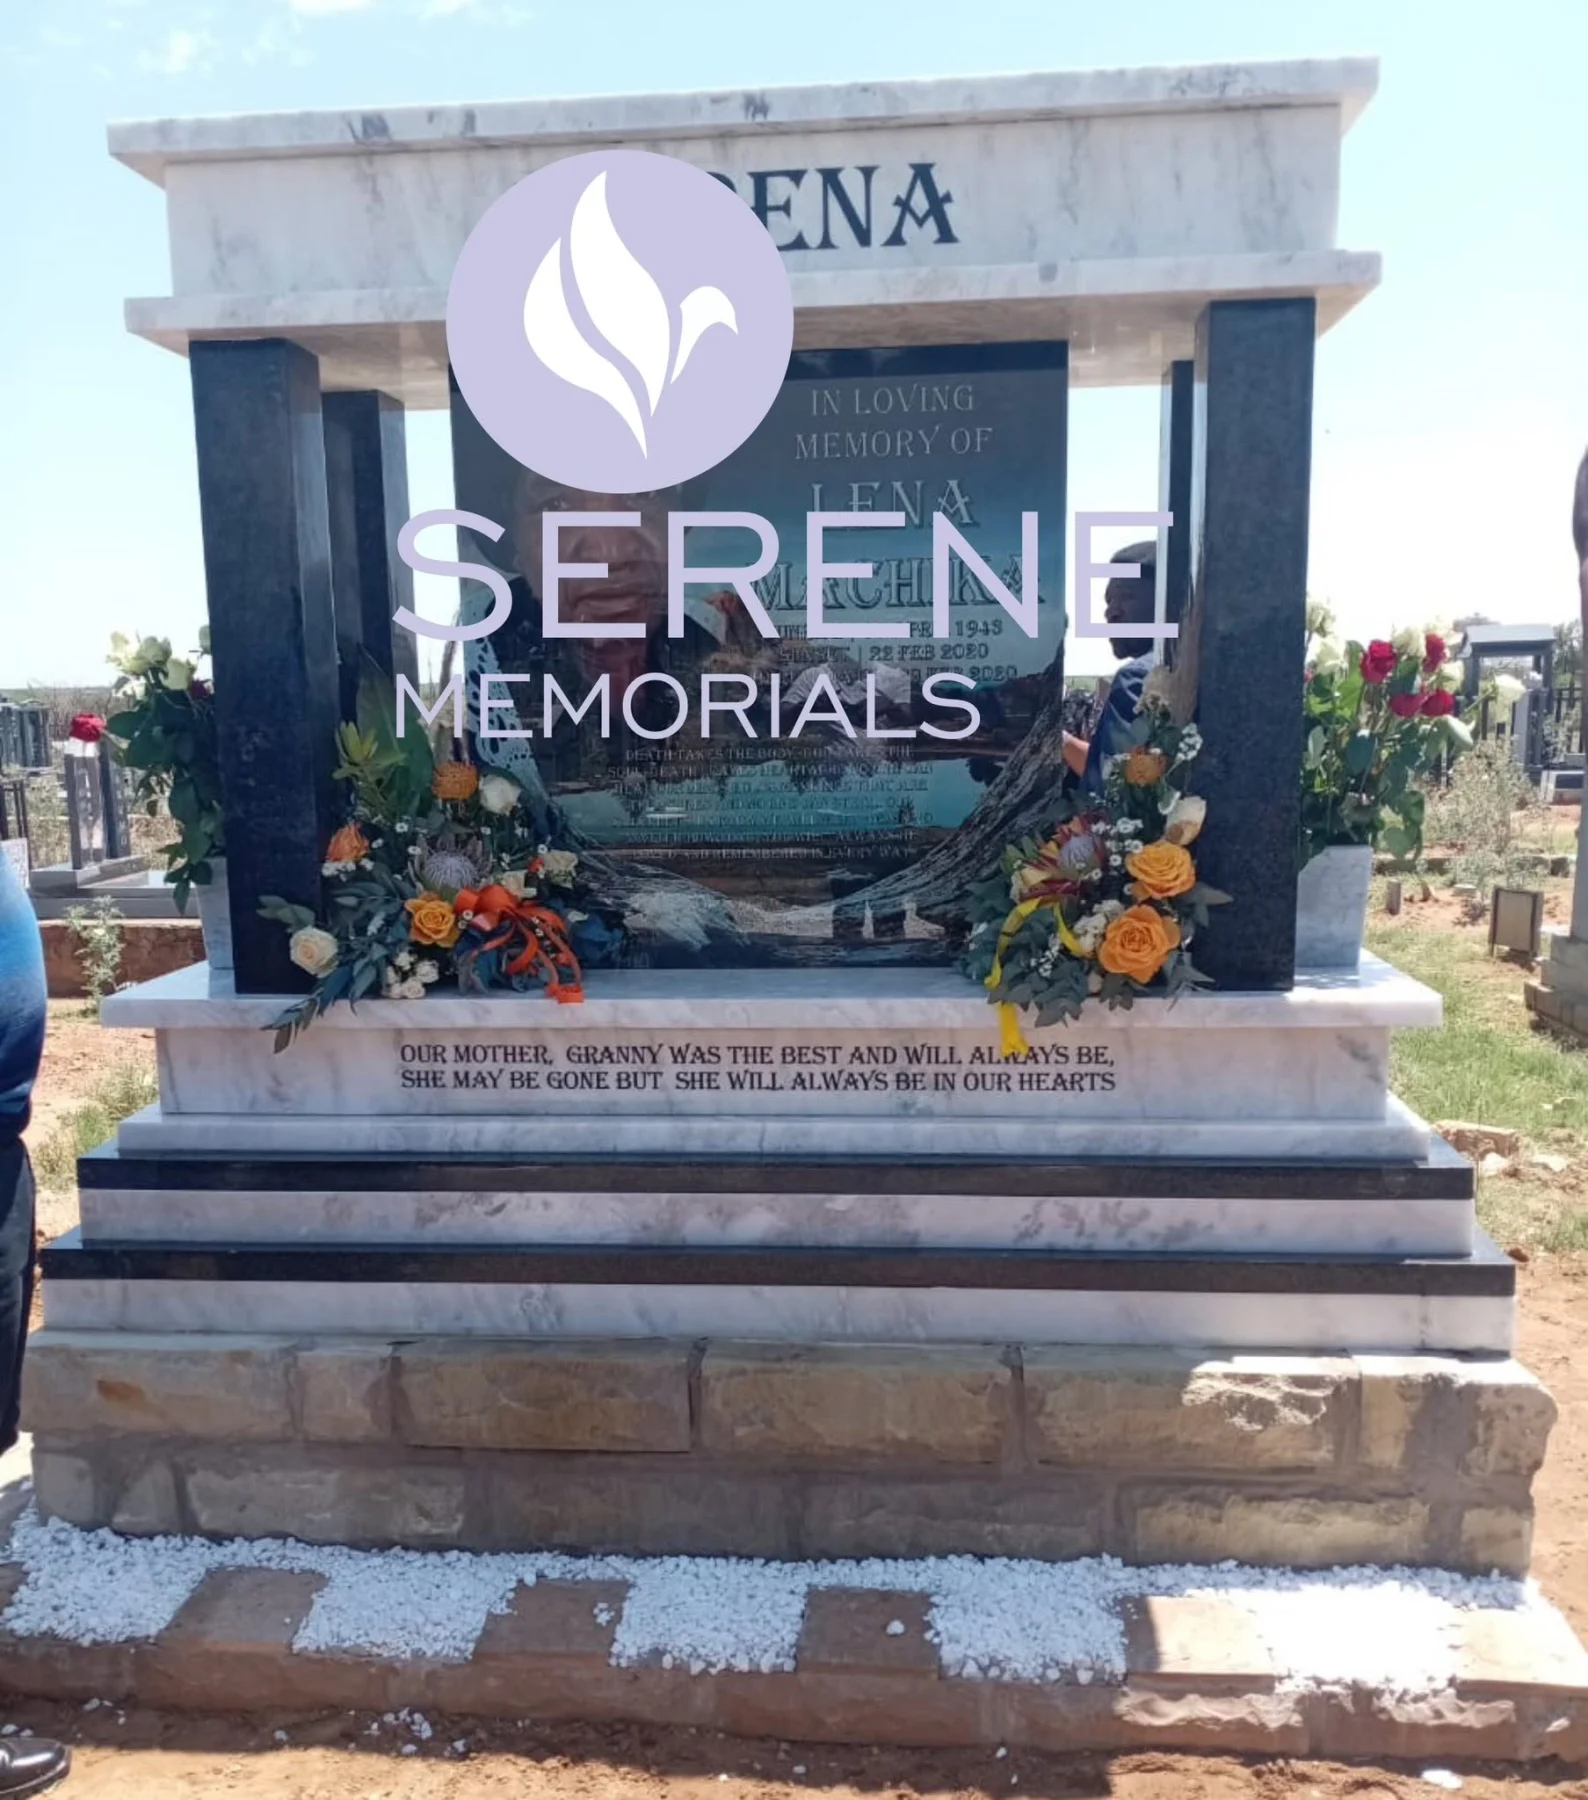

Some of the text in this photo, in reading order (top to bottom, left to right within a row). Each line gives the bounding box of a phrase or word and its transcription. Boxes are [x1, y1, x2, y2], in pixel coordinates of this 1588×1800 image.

[706, 162, 961, 252] ENA
[811, 383, 974, 416] IN LOVING
[795, 424, 993, 459] MEMORY OF
[745, 555, 1046, 611] MCHK
[898, 643, 935, 662] FEB
[940, 641, 990, 660] 2020
[400, 1042, 1116, 1068] OUR MOTHER, GRANNY WAS THE BEST AND WILL ALWAYS BE,
[401, 1068, 1116, 1092] SHE MAY BE GONE BUT SHE WILL ALWAYS BE IN OUR HEARTS
